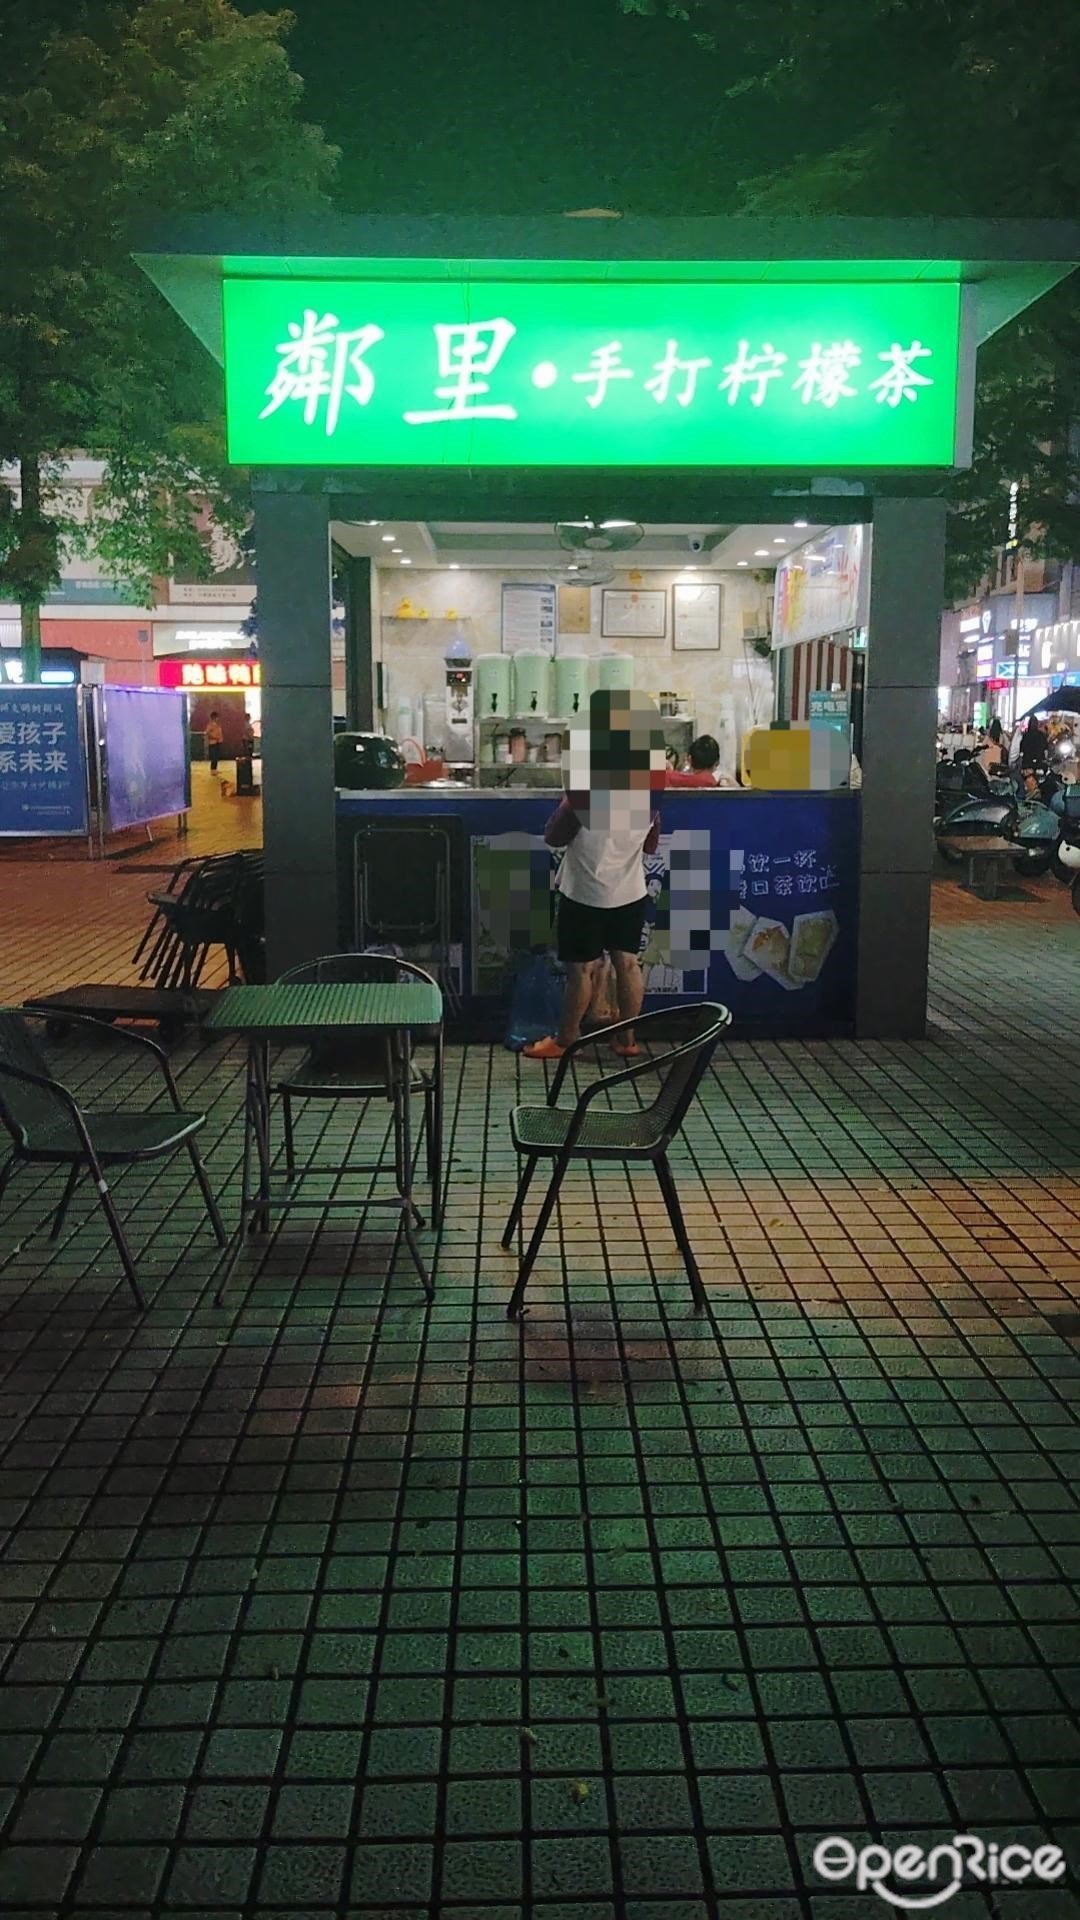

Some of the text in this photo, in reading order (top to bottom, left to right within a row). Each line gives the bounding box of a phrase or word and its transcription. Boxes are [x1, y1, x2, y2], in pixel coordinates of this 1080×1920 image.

[0, 721, 66, 745] 爱孩子
[0, 750, 69, 774] 系未来
[740, 849, 817, 875] 饮一杯
